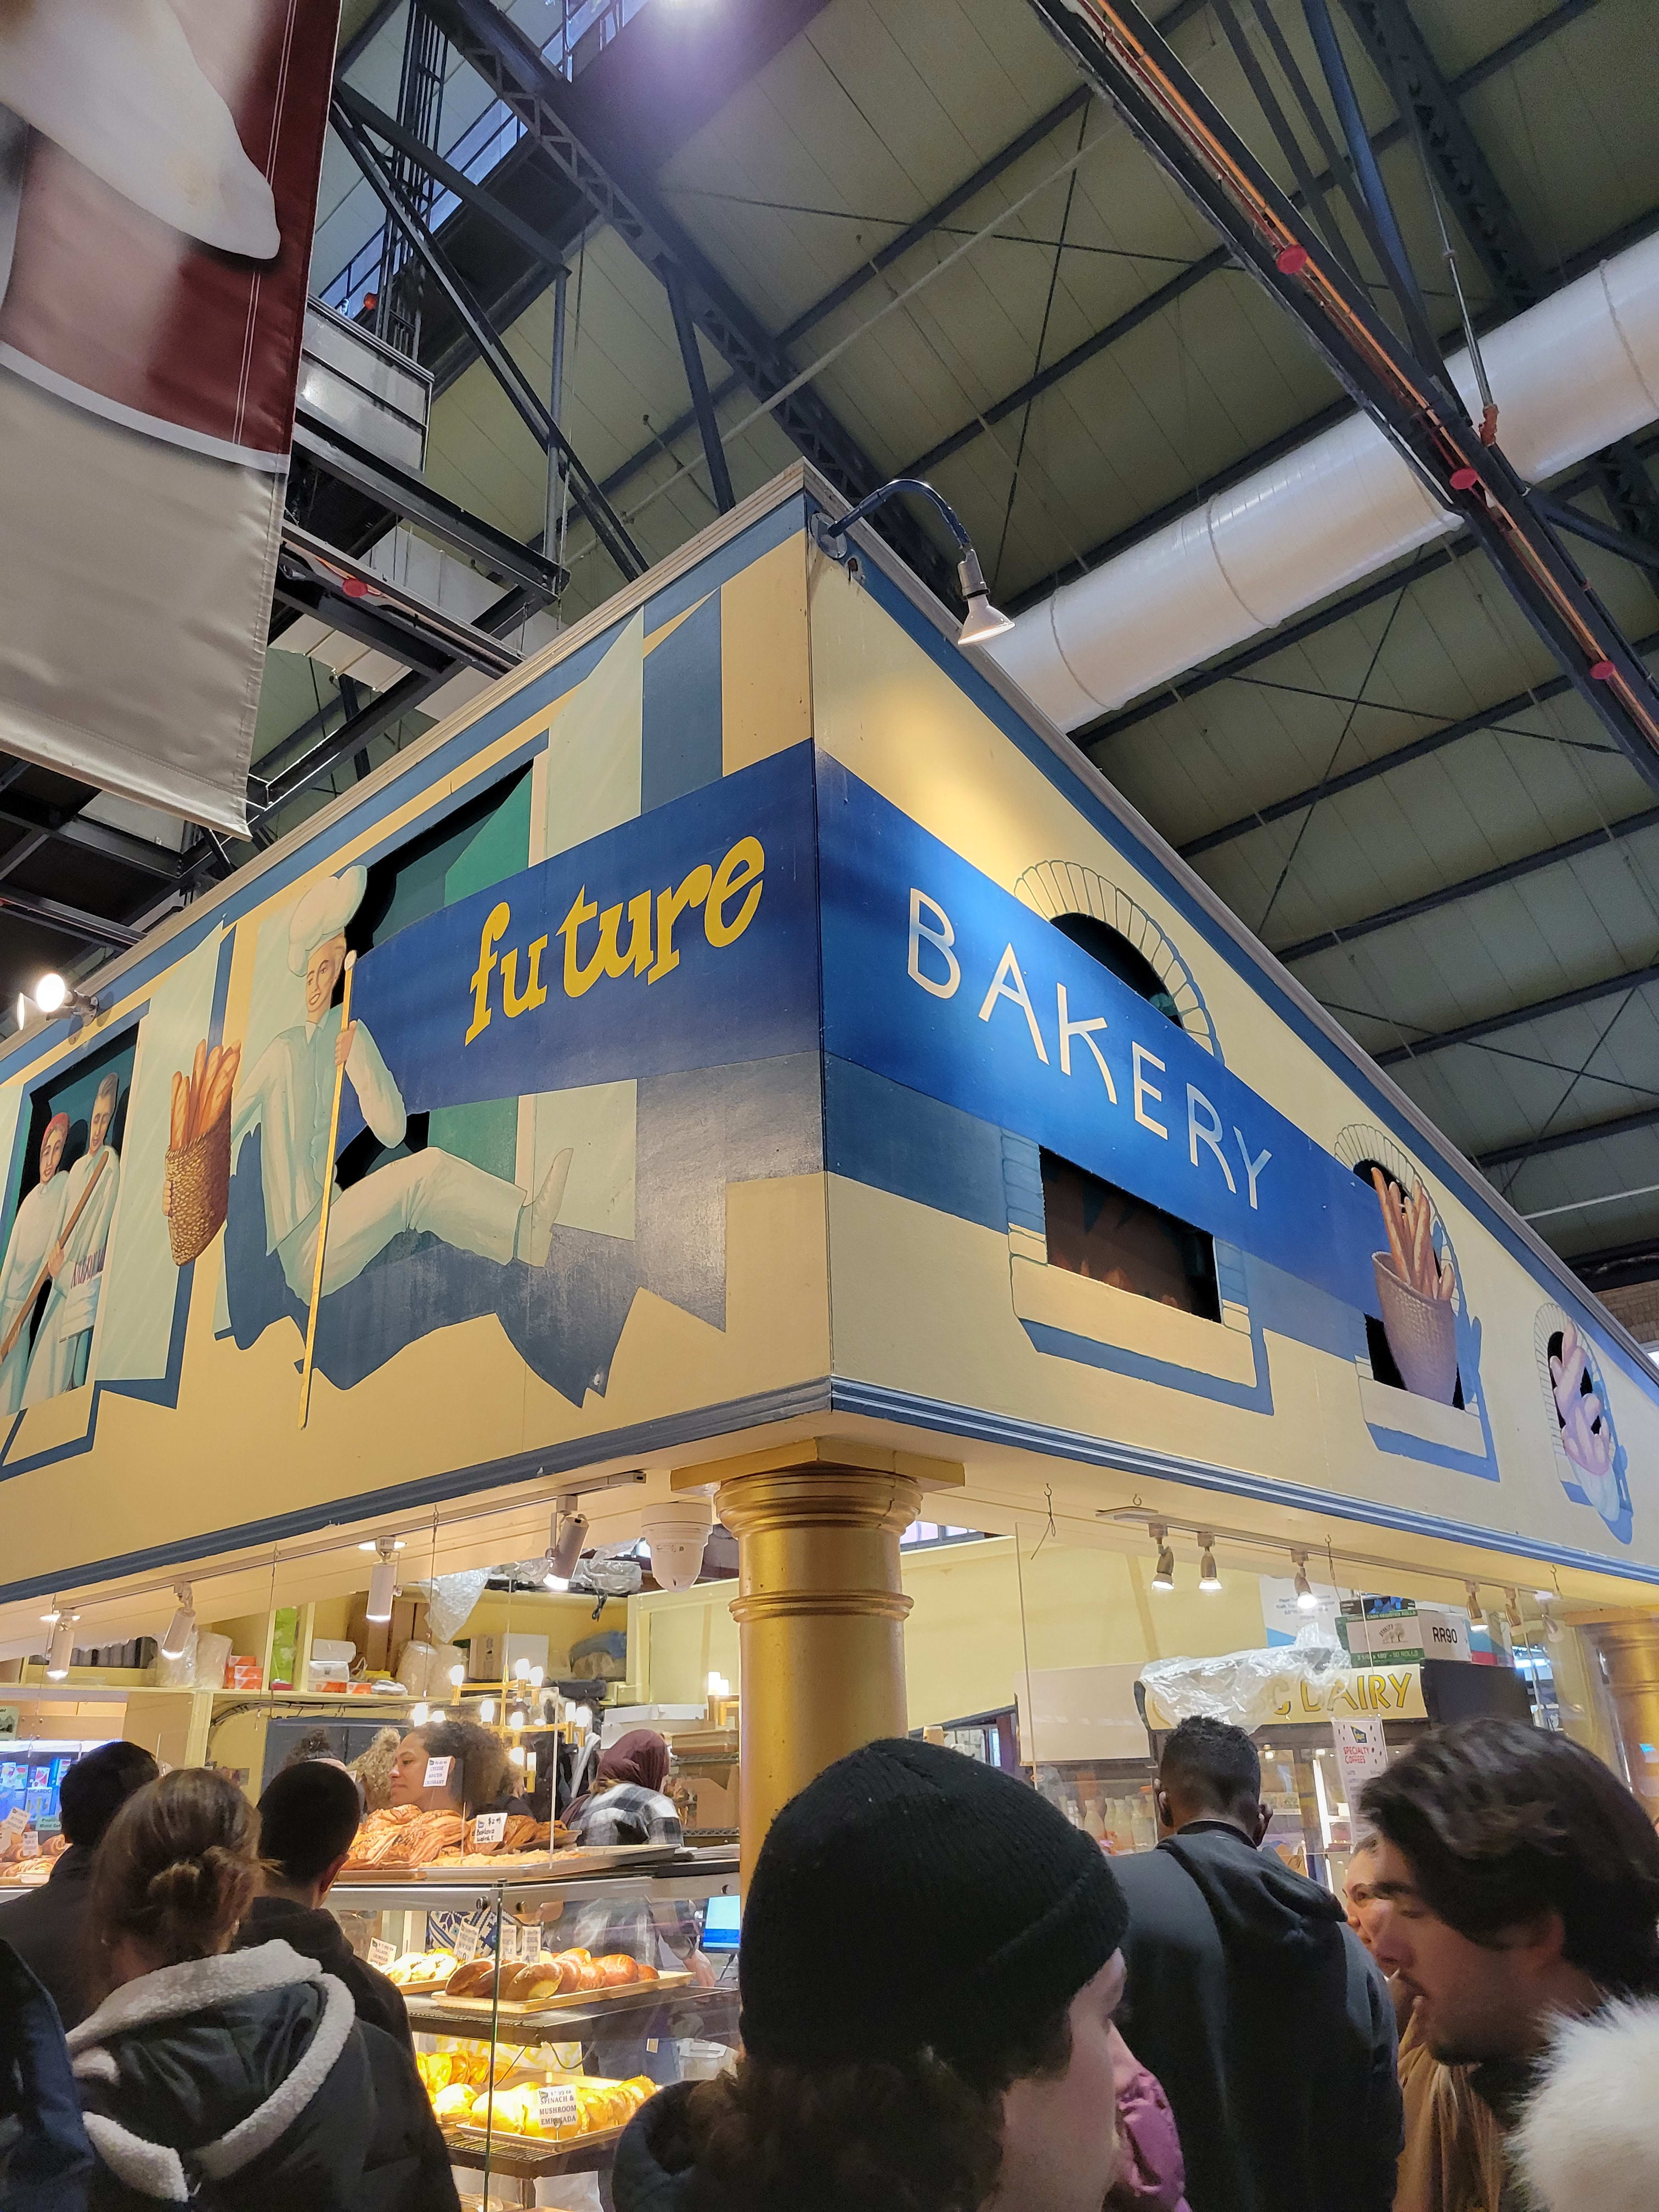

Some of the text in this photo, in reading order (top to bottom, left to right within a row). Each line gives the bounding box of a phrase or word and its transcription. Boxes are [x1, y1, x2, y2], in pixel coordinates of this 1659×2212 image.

[465, 836, 765, 1047] future
[907, 887, 1273, 1210] BAKERY
[1432, 1626, 1458, 1644] RR90
[1300, 1672, 1412, 1712] DAIRY
[1343, 1746, 1369, 1756] SPECIALTY
[1345, 1755, 1366, 1764] COFFEES
[540, 2095, 568, 2105] SPINACH
[539, 2104, 577, 2115] MUSHROOM
[541, 2115, 576, 2125] EMPADA
